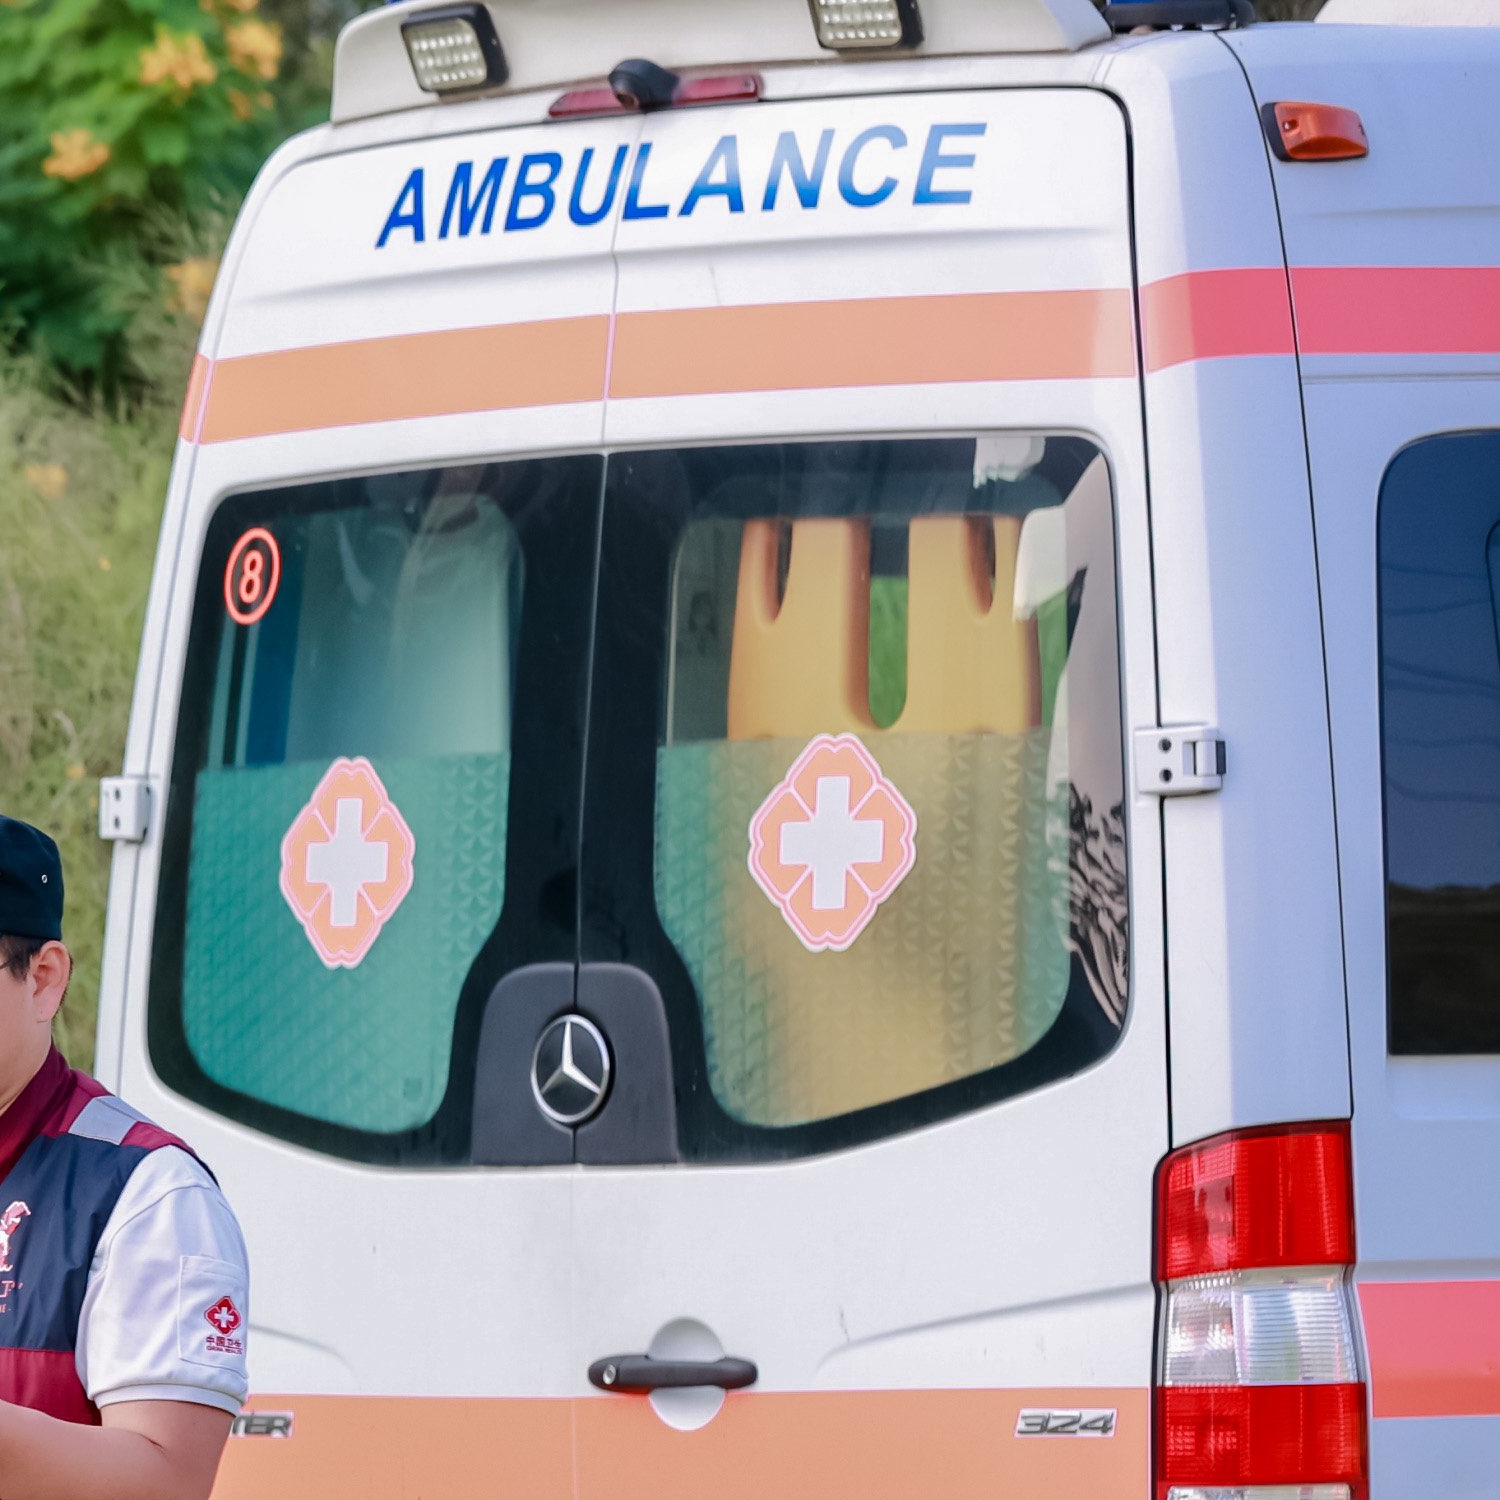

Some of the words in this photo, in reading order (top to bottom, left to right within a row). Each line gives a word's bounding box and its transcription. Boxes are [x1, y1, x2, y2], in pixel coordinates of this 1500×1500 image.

[376, 122, 988, 249] AMBULANCE
[239, 549, 264, 604] 8
[1017, 1412, 1114, 1434] 324
